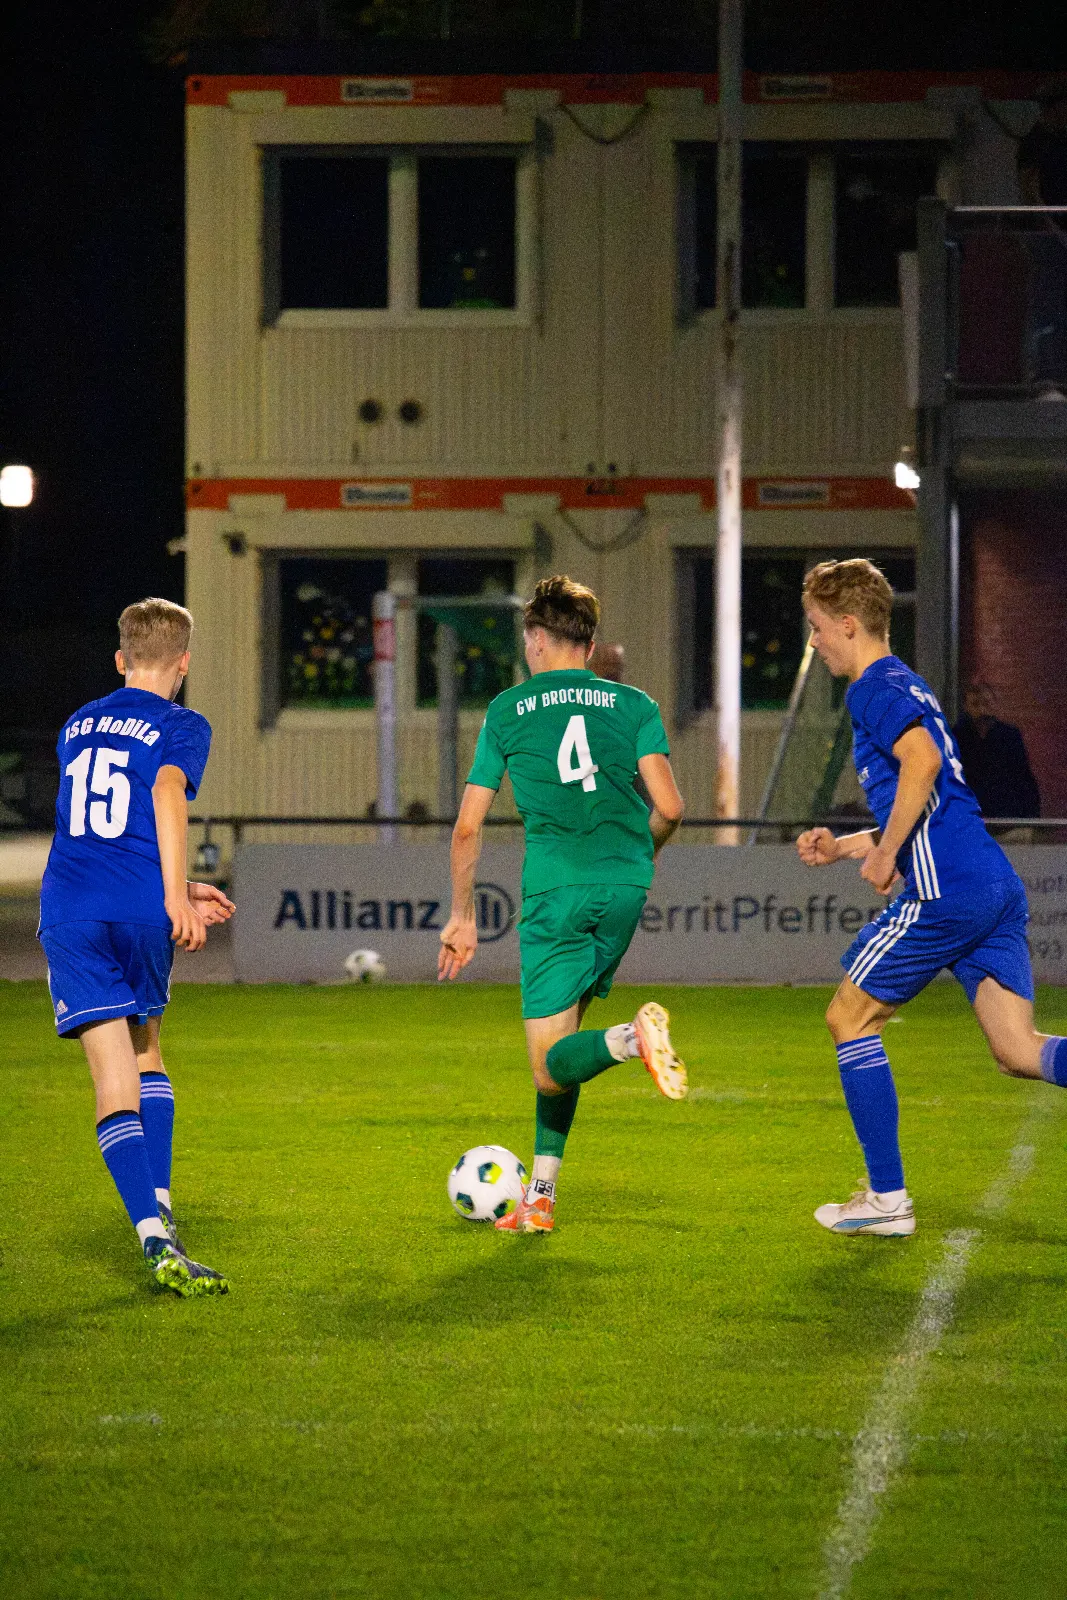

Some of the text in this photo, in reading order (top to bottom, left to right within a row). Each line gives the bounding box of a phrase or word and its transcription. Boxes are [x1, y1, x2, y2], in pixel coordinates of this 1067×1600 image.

[516, 688, 618, 716] GW BROCKDORF
[95, 716, 160, 747] HoDiLa
[557, 714, 599, 793] 4
[65, 747, 131, 839] 15
[274, 888, 443, 930] Allianz
[640, 894, 888, 934] erritPfeffer
[535, 1179, 554, 1197] FS
